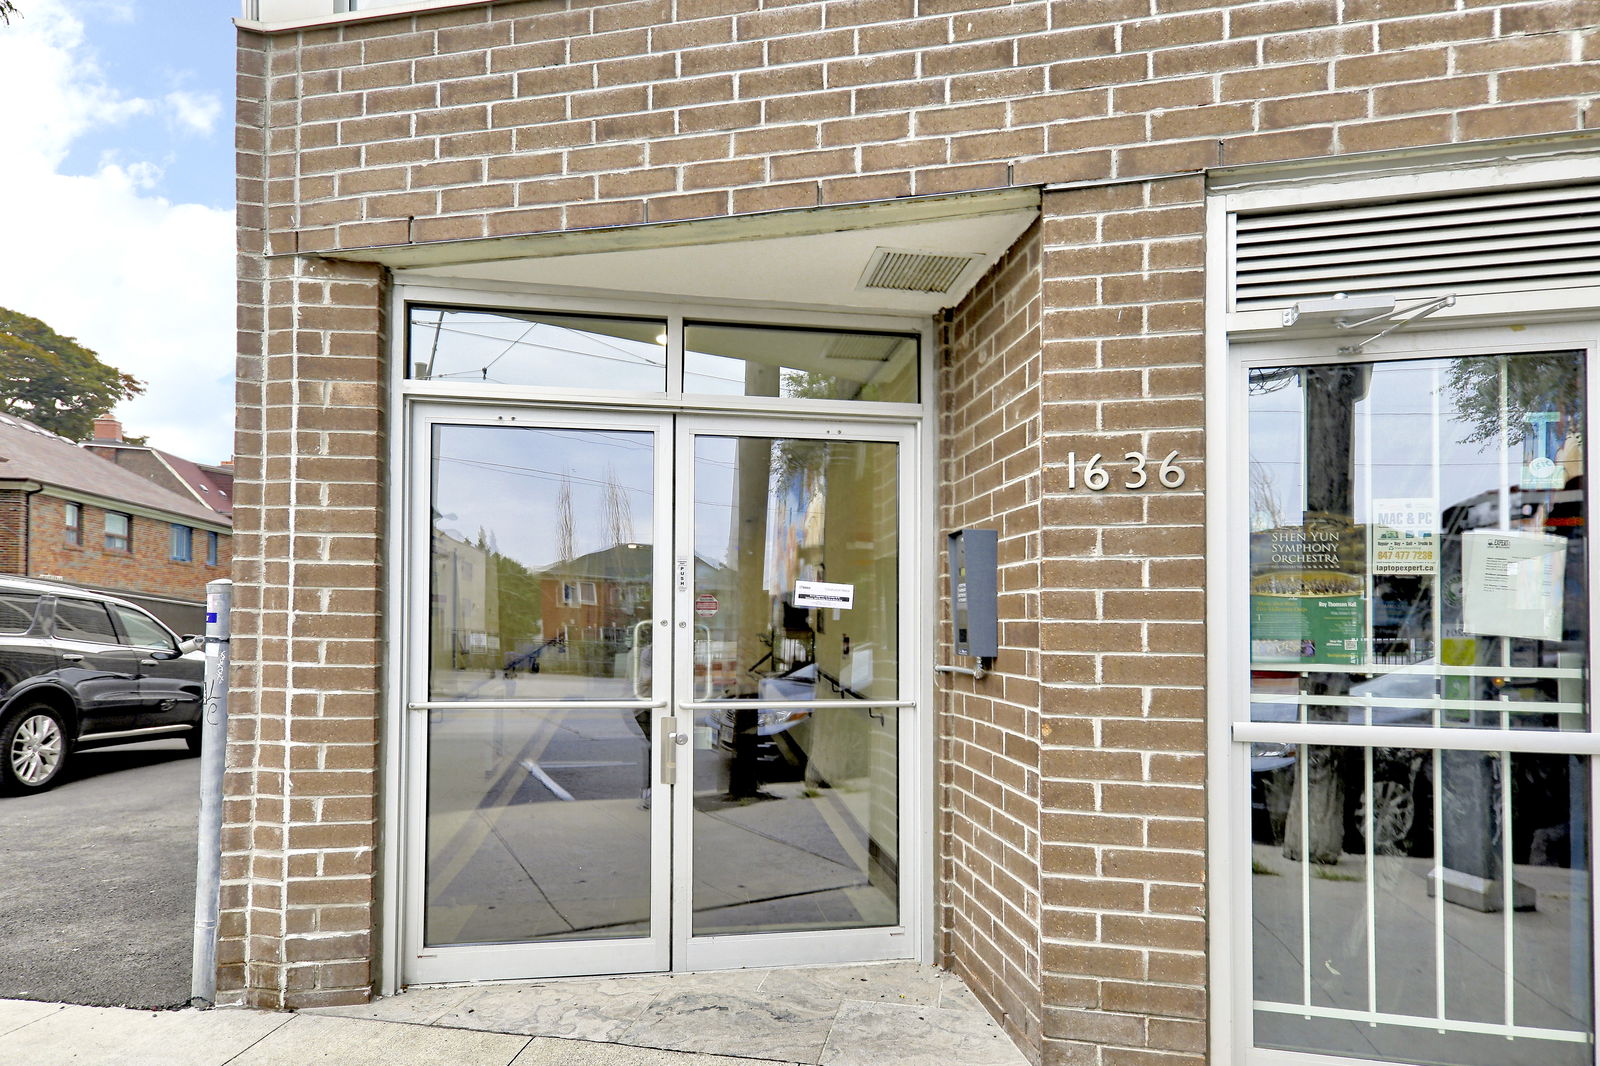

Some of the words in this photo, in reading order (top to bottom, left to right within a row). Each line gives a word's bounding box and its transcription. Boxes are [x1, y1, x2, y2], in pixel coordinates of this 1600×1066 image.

[1067, 449, 1186, 491] 1636
[1377, 512, 1404, 525] MAC
[1406, 512, 1415, 525] &
[1417, 511, 1433, 525] PC
[1271, 531, 1306, 542] SHEN
[1309, 531, 1340, 542] YUN
[1271, 543, 1339, 553] SYMPHONY
[1271, 554, 1340, 565] ORCHESTRA
[1376, 564, 1434, 572] laptopexpert.ca
